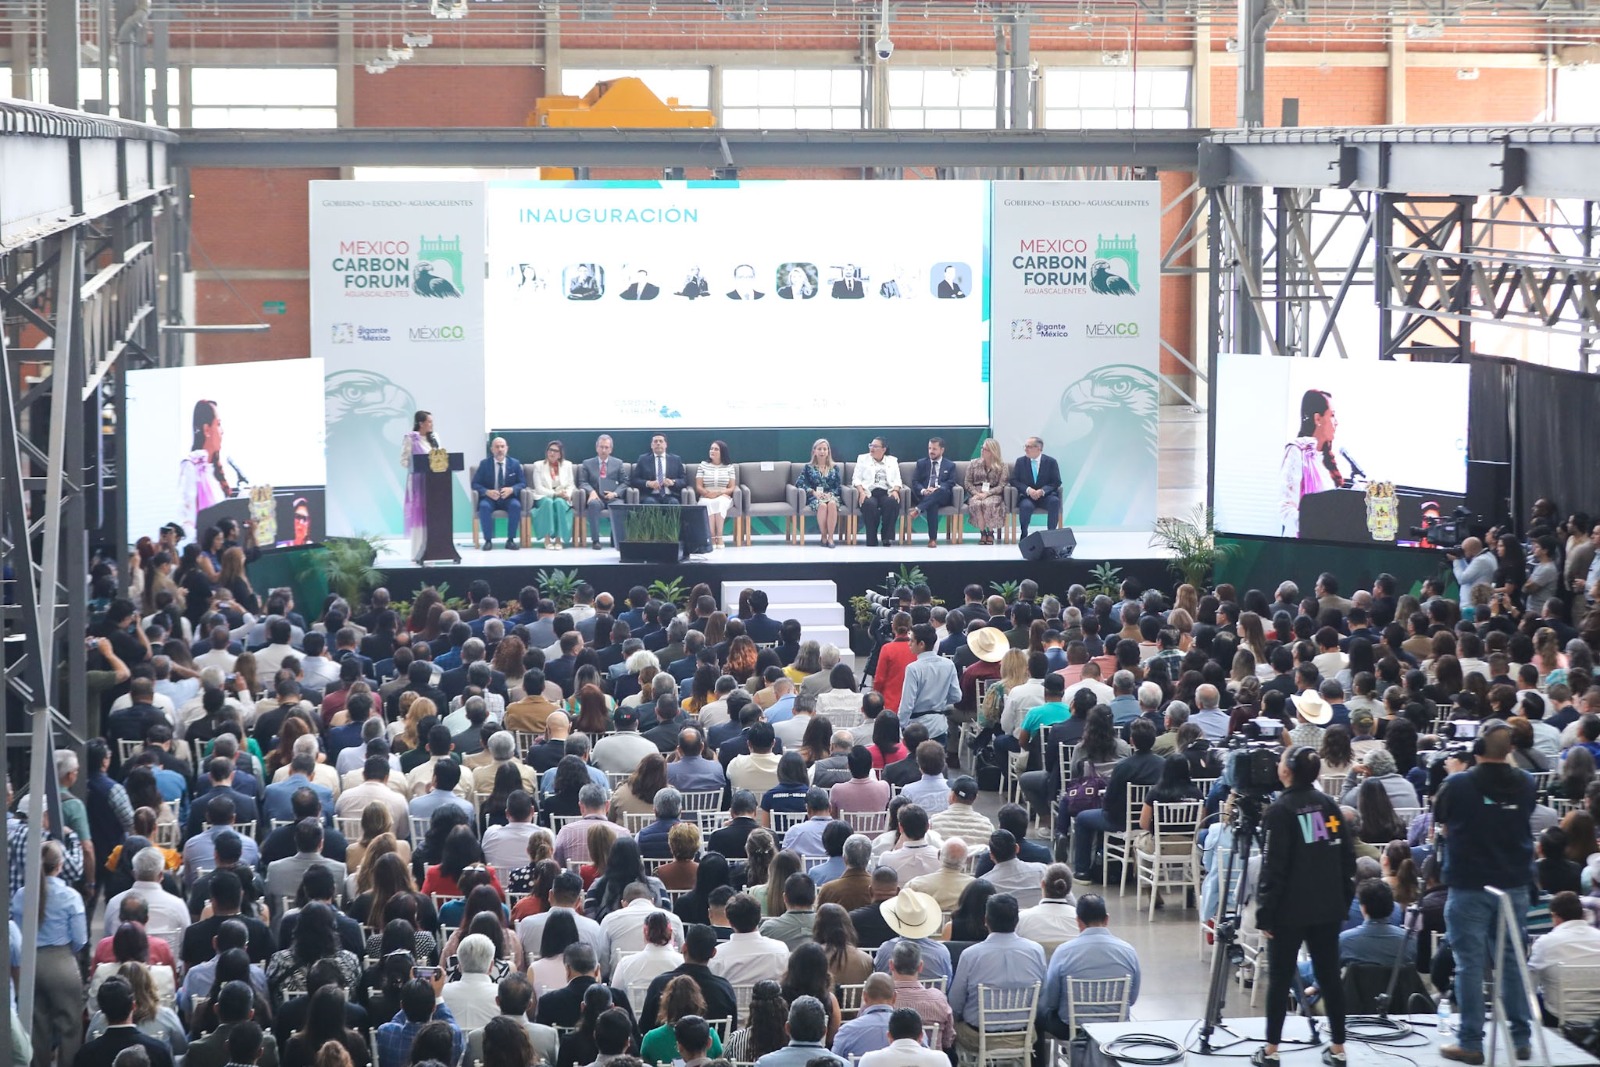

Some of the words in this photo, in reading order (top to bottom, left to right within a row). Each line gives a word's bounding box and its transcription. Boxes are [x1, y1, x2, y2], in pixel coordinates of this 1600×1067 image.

[372, 199, 402, 207] ESTADO
[408, 199, 473, 207] AGUASCALIENTES
[1004, 199, 1045, 207] GOBIERNO
[1086, 199, 1149, 207] AGUASCALIENTES
[519, 204, 698, 223] INAUGURACIÓN
[340, 241, 409, 255] MEXICO
[1020, 239, 1087, 253] MEXICO
[332, 257, 409, 272] CARBON
[1012, 255, 1087, 270] CARBON
[344, 274, 409, 288] FORUM
[1024, 272, 1087, 286] FORUM
[344, 290, 410, 298] AGUASCALIENTES
